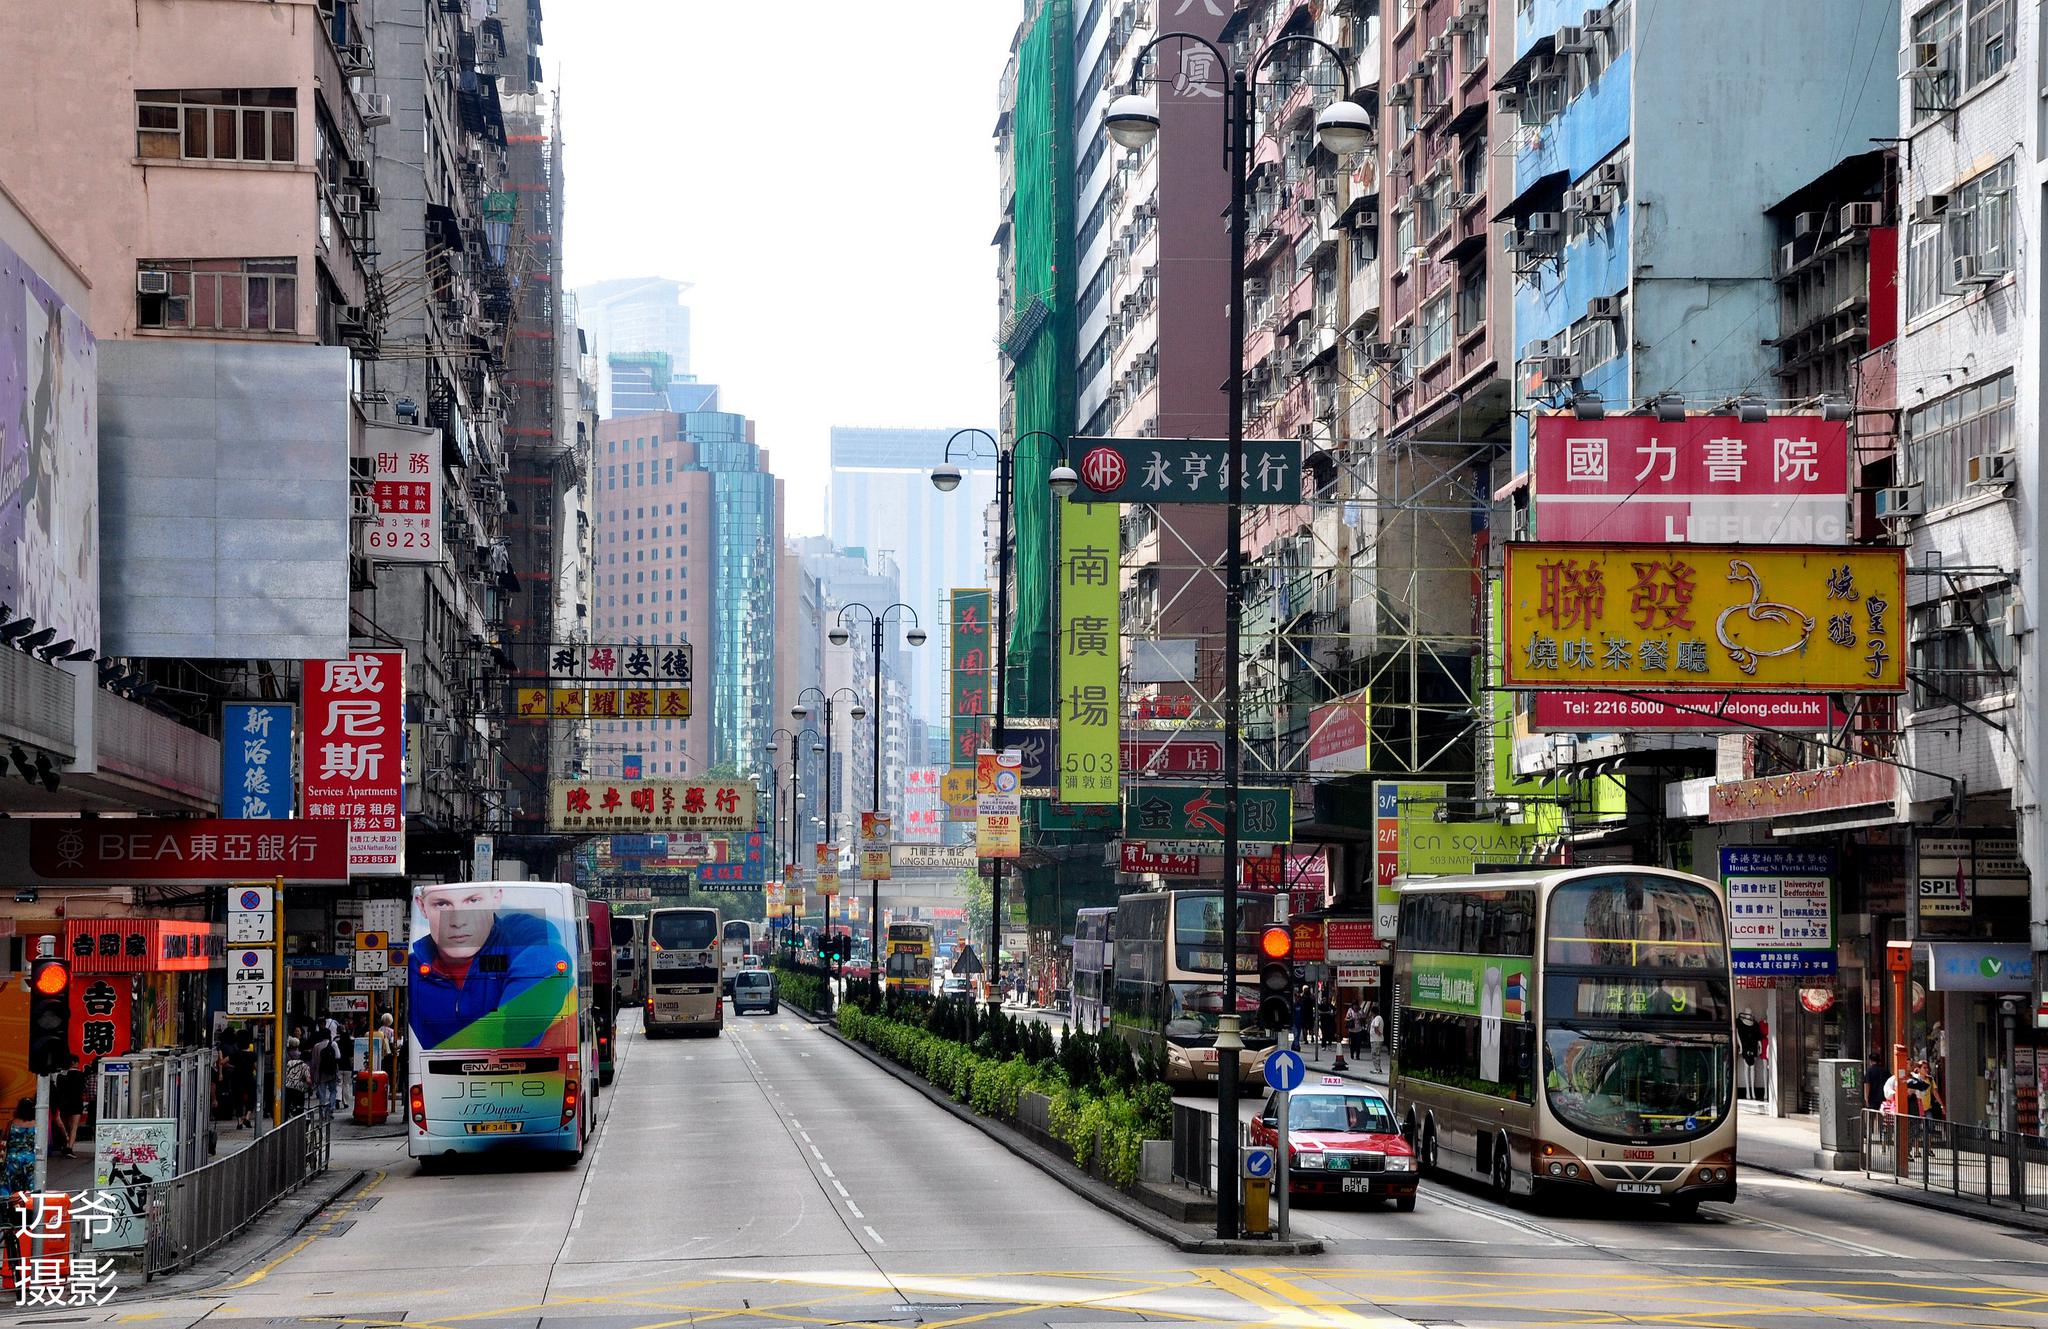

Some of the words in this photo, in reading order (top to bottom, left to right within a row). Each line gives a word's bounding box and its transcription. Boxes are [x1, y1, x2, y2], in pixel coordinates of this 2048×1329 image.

[378, 453, 429, 473] 財務
[1566, 437, 1820, 482] 國力書院
[1665, 515, 1840, 543] LIFELONG
[370, 532, 430, 548] 6923
[1536, 558, 1698, 632] 聯發
[1069, 500, 1109, 728] 南廣場
[1523, 639, 1709, 673] 燒味茶餐廳
[1563, 700, 1590, 714] Tel:
[1594, 700, 1628, 714] 2216
[1631, 700, 1664, 714] 5000
[1676, 699, 1821, 718] www.lifelong.edu.hk
[320, 654, 385, 781] 威尼斯
[242, 706, 272, 819] 新浴德池
[1066, 753, 1113, 772] 503
[1065, 776, 1113, 790] 彌敦道
[308, 786, 343, 797] Services
[347, 785, 398, 799] Apartments
[1379, 796, 1397, 809] 3/F
[309, 803, 335, 817] 賓館
[340, 803, 365, 816] 訂房
[369, 803, 396, 816] 租房
[987, 817, 1009, 826] 15-20
[1379, 830, 1397, 843] 2/F
[1452, 835, 1532, 850] SQUARE
[100, 834, 184, 861] BEA
[190, 833, 318, 862] 東亞銀行
[371, 855, 395, 863] 8587
[899, 857, 925, 866] KINGS
[928, 858, 940, 866] De
[941, 858, 975, 866] NATHAN
[1379, 863, 1397, 877] 1/F
[1729, 865, 1748, 873] Hong
[1750, 865, 1769, 873] Kong
[1784, 880, 1815, 889] University
[1816, 880, 1825, 888] of
[1920, 880, 1951, 894] SPI
[1783, 889, 1825, 897] Bedfordshire
[257, 914, 265, 924] 7
[1380, 915, 1398, 928] G/F
[257, 930, 265, 940] 7
[1735, 926, 1756, 934] LCCI
[87, 933, 147, 957] 吉野家
[256, 986, 263, 995] 7
[1671, 986, 1687, 1012] 9
[256, 1002, 270, 1012] 12
[441, 1082, 514, 1099] JET
[521, 1081, 546, 1096] 8
[482, 1103, 531, 1117] Dupont
[1344, 1184, 1368, 1192] 8216
